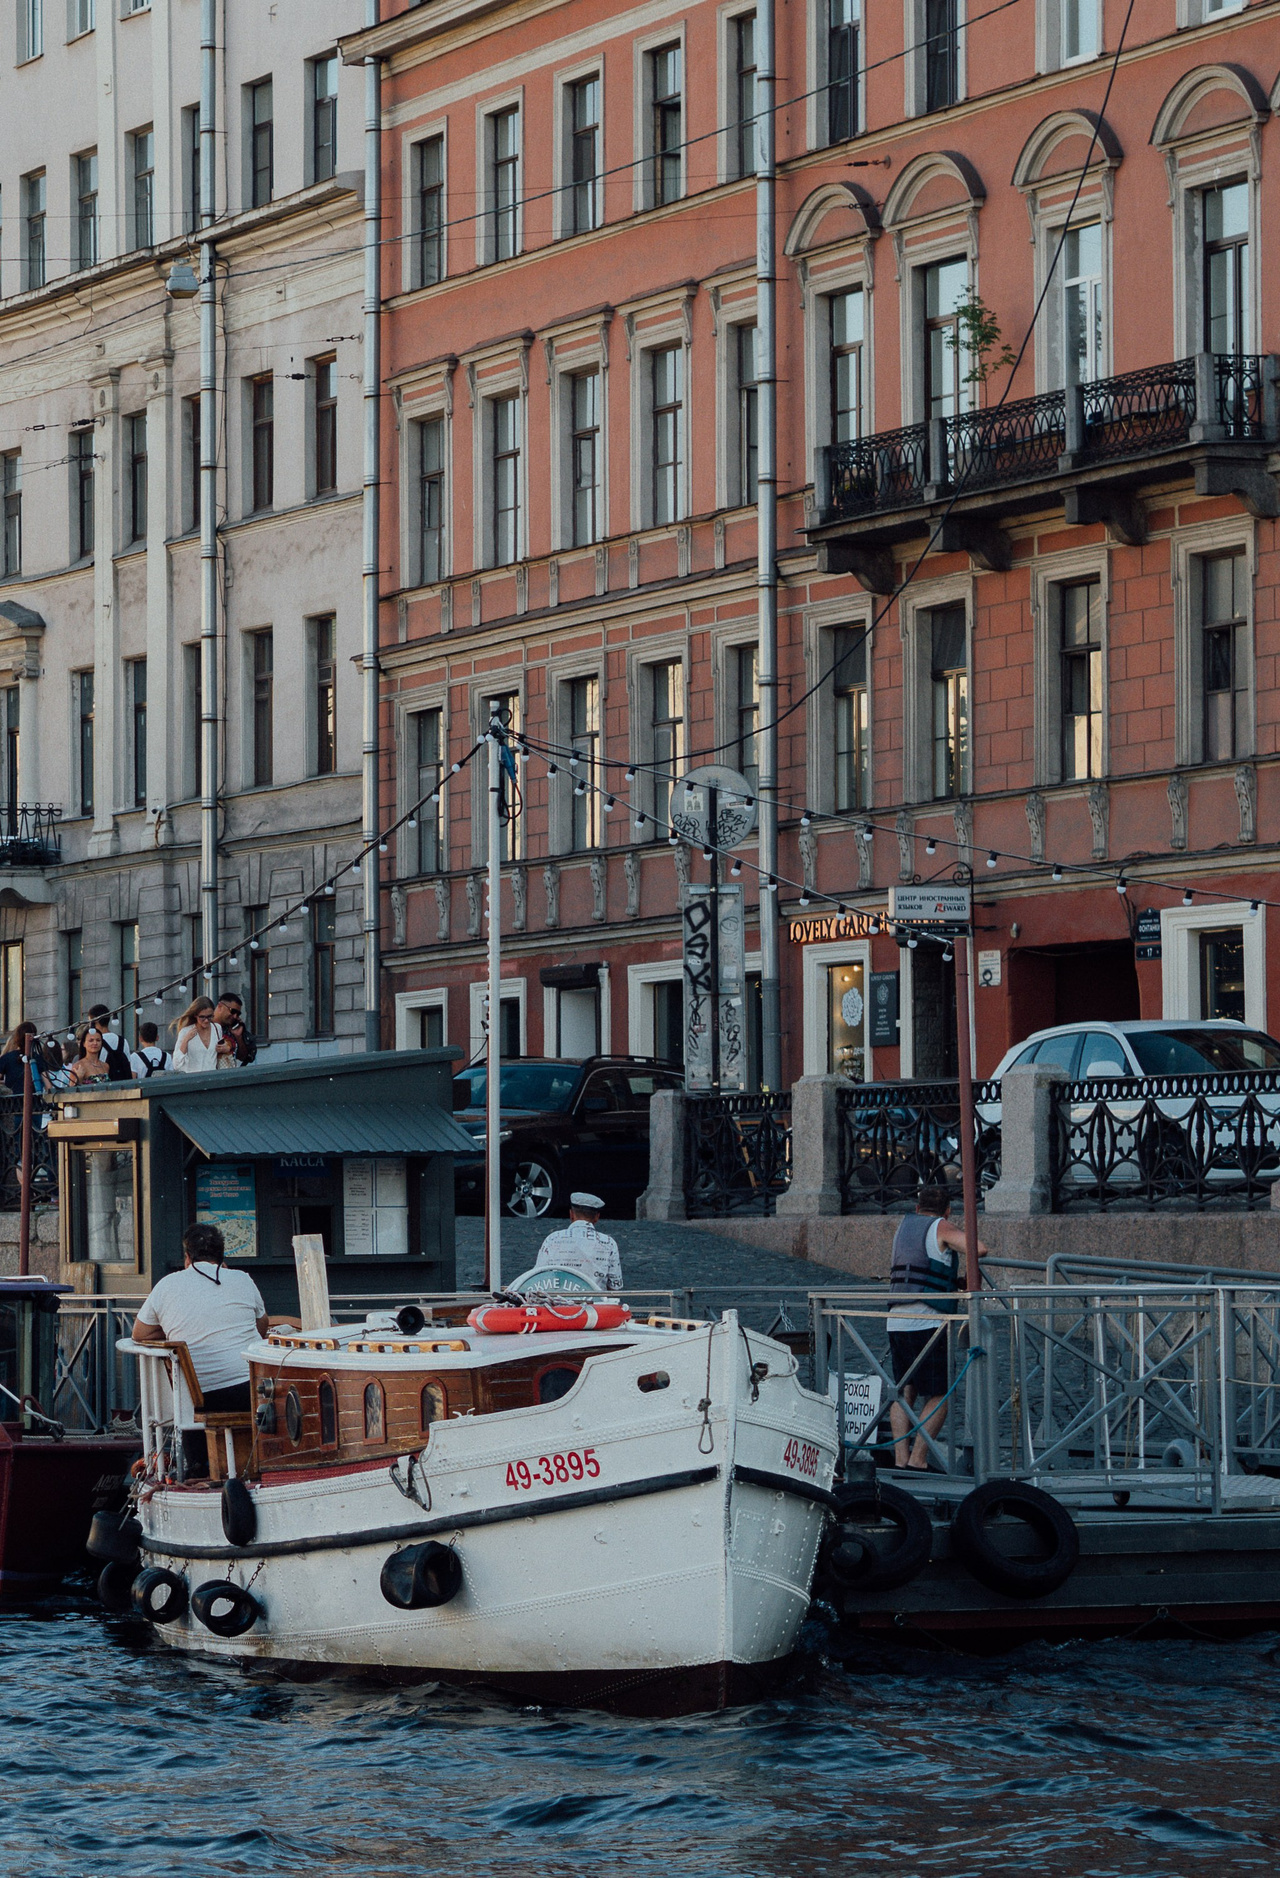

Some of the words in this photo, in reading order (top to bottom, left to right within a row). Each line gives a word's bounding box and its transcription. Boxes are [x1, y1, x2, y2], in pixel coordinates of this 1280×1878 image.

[788, 918, 835, 943] LOVELY
[1147, 947, 1153, 957] 17
[844, 1383, 870, 1400] РОХОД
[505, 1448, 601, 1491] 49-3895
[783, 1438, 820, 1478] 49-3895
